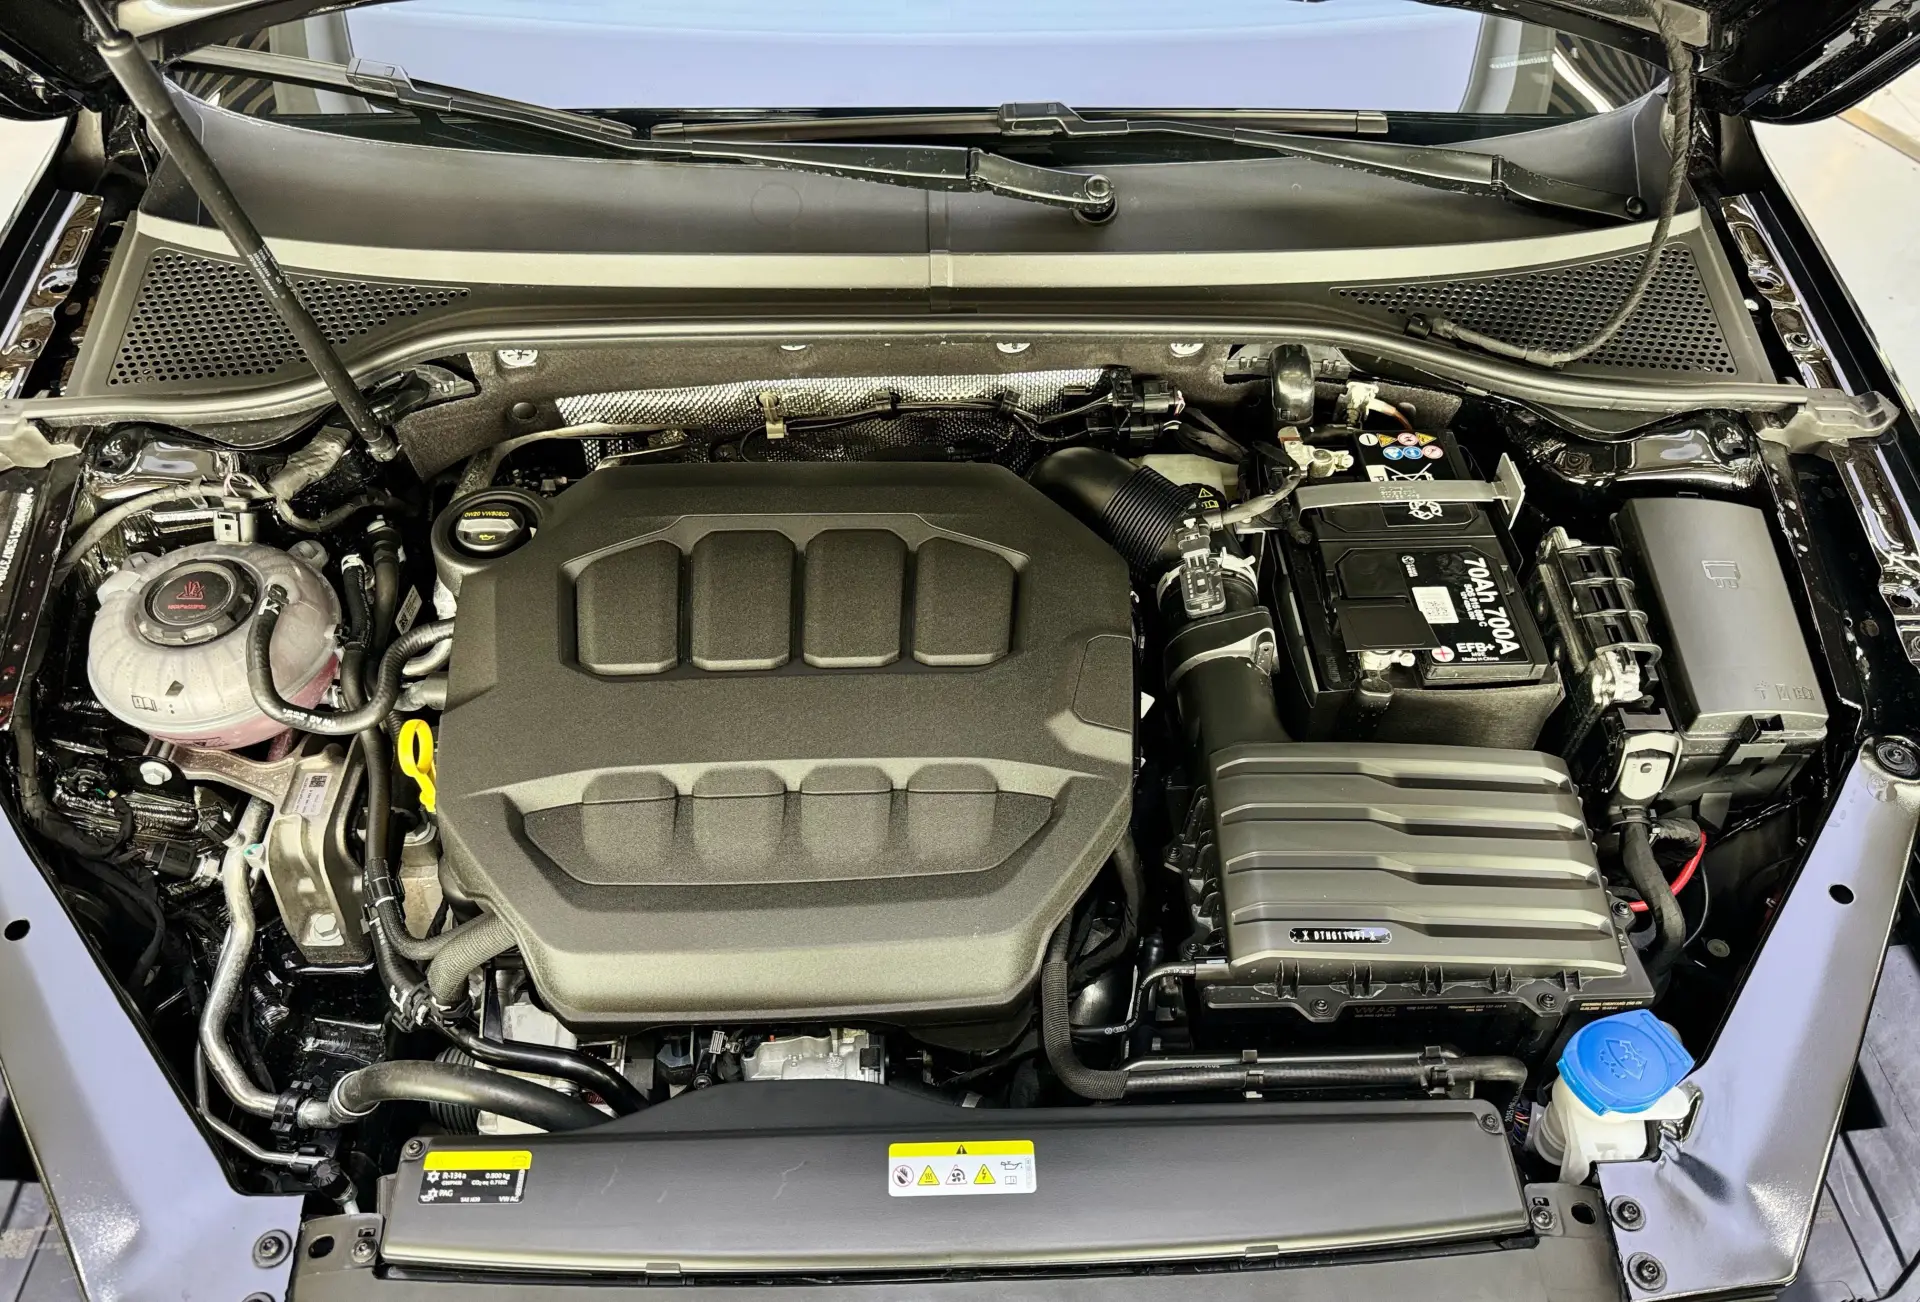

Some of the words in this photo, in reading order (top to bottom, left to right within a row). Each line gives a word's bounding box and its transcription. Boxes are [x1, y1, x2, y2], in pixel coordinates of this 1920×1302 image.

[1463, 557, 1499, 603] 70Ah
[1484, 606, 1521, 655] 700A
[1456, 642, 1496, 653] EFB+
[309, 714, 323, 724] AG
[1376, 1005, 1397, 1013] AG
[438, 1189, 454, 1197] PAG
